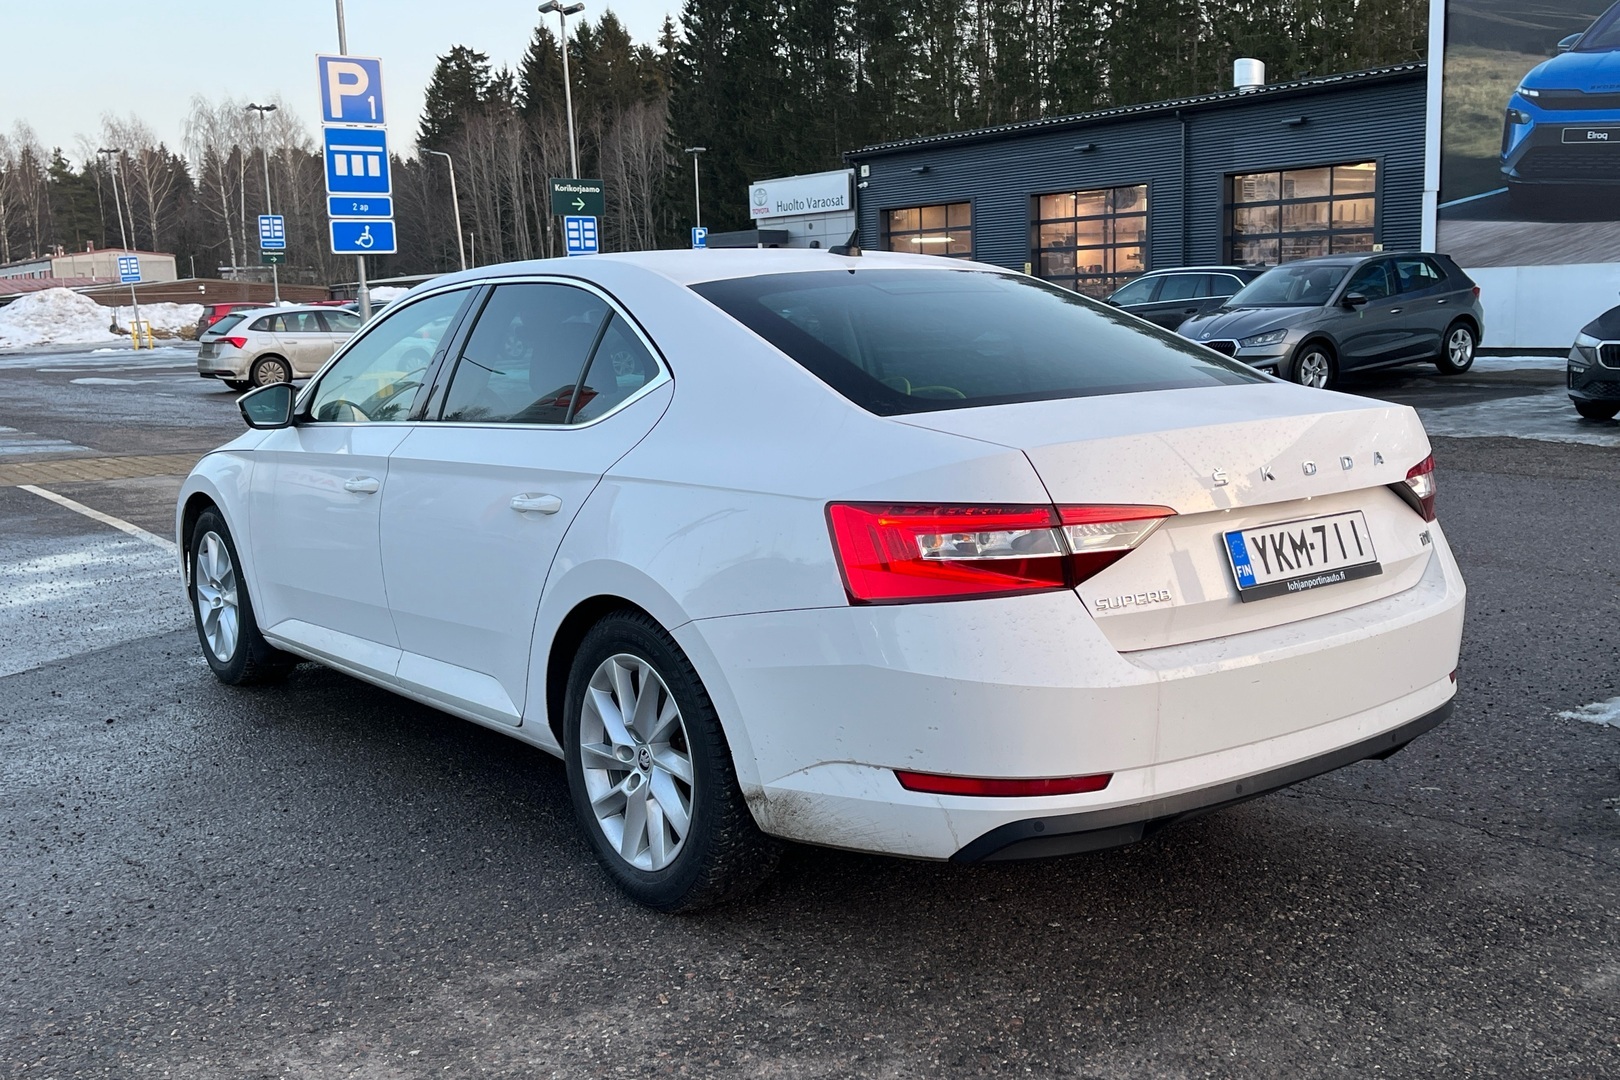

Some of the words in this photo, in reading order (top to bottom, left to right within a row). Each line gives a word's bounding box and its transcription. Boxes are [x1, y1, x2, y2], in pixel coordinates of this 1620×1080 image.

[327, 61, 369, 118] P
[368, 96, 376, 119] 1
[1587, 131, 1608, 140] Elroq
[554, 184, 600, 194] Korikorjaamo
[352, 203, 358, 211] 2
[359, 204, 369, 212] ap
[752, 207, 769, 215] TOYOTA
[776, 198, 804, 212] Huolto
[806, 194, 844, 209] Varaosat
[696, 229, 706, 244] P
[1212, 451, 1384, 487] ŠKODA
[1251, 520, 1364, 575] YKM-711
[1236, 564, 1253, 578] FIN
[1286, 571, 1346, 591] lohjanportinauto.fi
[1095, 589, 1172, 611] SUPERB
